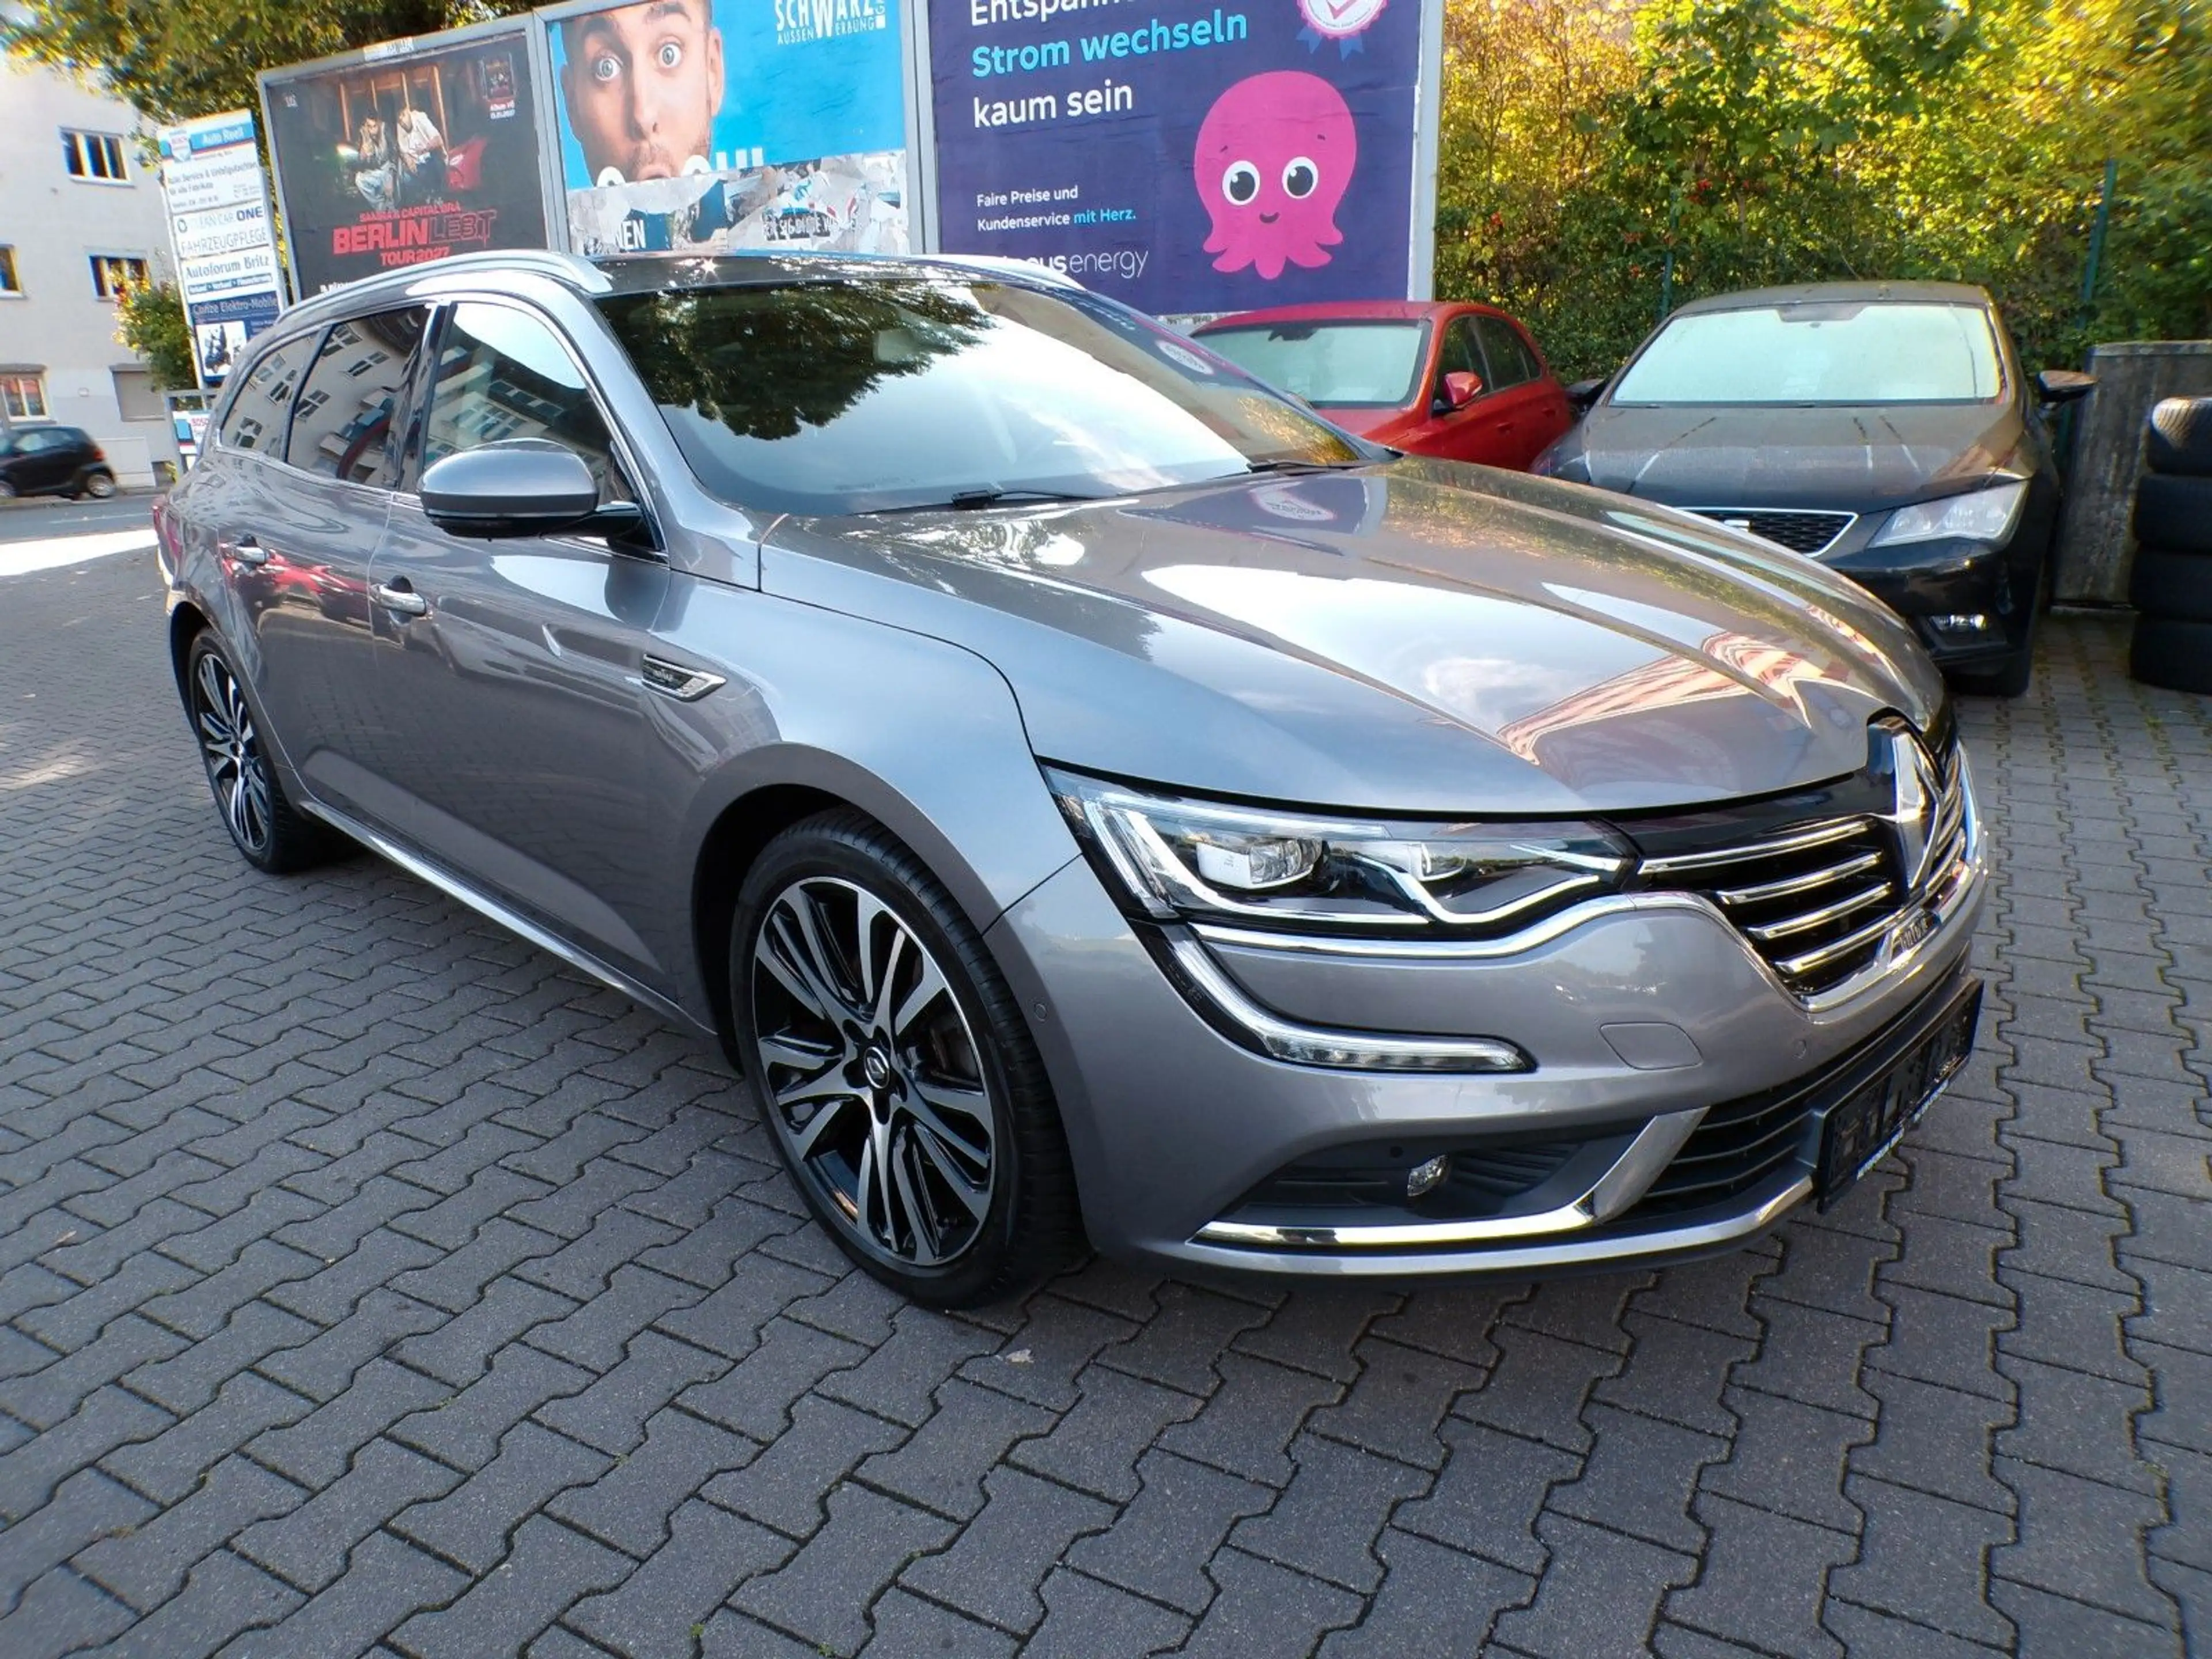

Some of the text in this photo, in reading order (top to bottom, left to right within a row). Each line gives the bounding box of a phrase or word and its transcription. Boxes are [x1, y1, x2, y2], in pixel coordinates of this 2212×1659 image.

[971, 0, 1135, 26] Entspa
[972, 9, 1248, 77] Strom wechseln
[974, 78, 1132, 128] kaum sein
[977, 185, 1078, 207] Faire Preise und
[236, 206, 264, 222] ONE
[978, 208, 1136, 231] Kundenservice mit Herz.
[181, 227, 267, 255] FAHRZEUGPFLEGE
[333, 218, 429, 255] BERLIN
[185, 254, 270, 278] Autoforum Britz
[380, 249, 415, 266] TOUR
